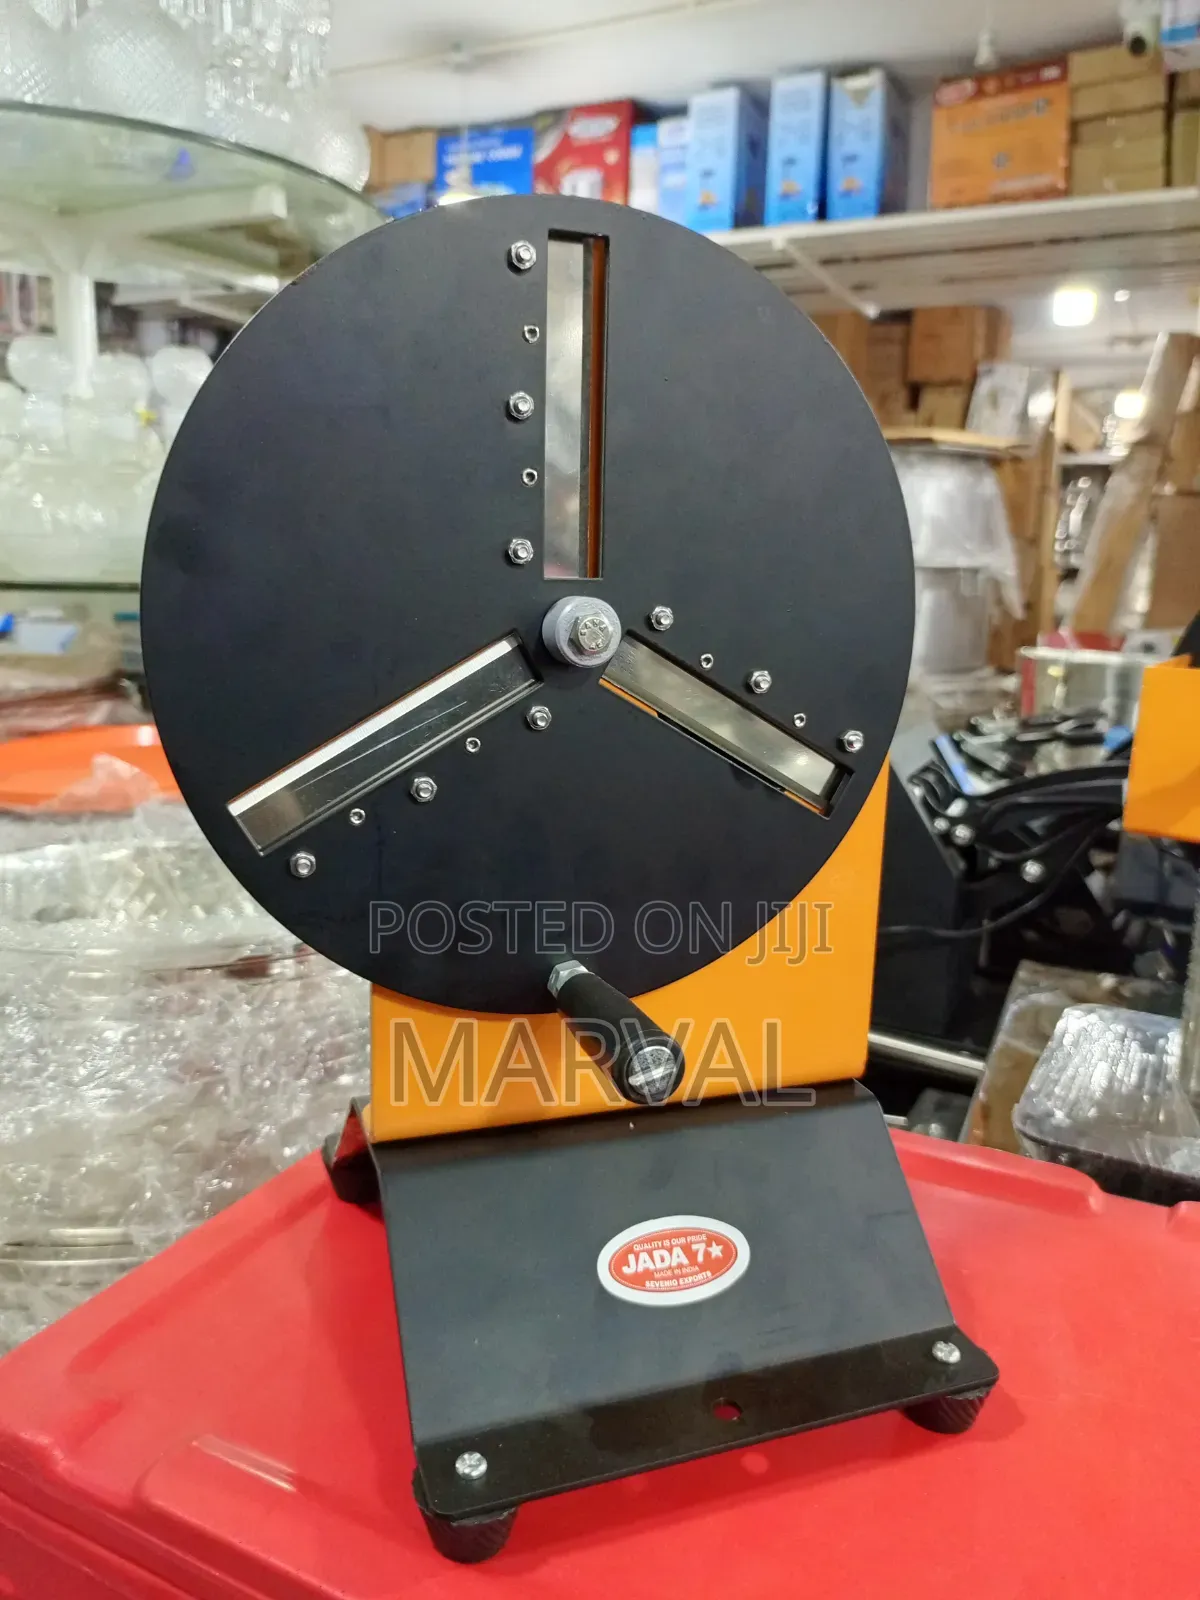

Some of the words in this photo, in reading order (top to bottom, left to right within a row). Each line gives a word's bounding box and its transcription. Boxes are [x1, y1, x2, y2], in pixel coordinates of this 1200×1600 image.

[633, 1241, 662, 1251] QUALITY
[671, 1236, 686, 1245] OUR
[687, 1233, 708, 1242] PRIDE
[622, 1246, 689, 1275] JADA
[653, 1269, 674, 1279] MADE
[674, 1267, 682, 1276] IN
[682, 1265, 700, 1274] INDIA
[679, 1270, 712, 1285] EXPORTS
